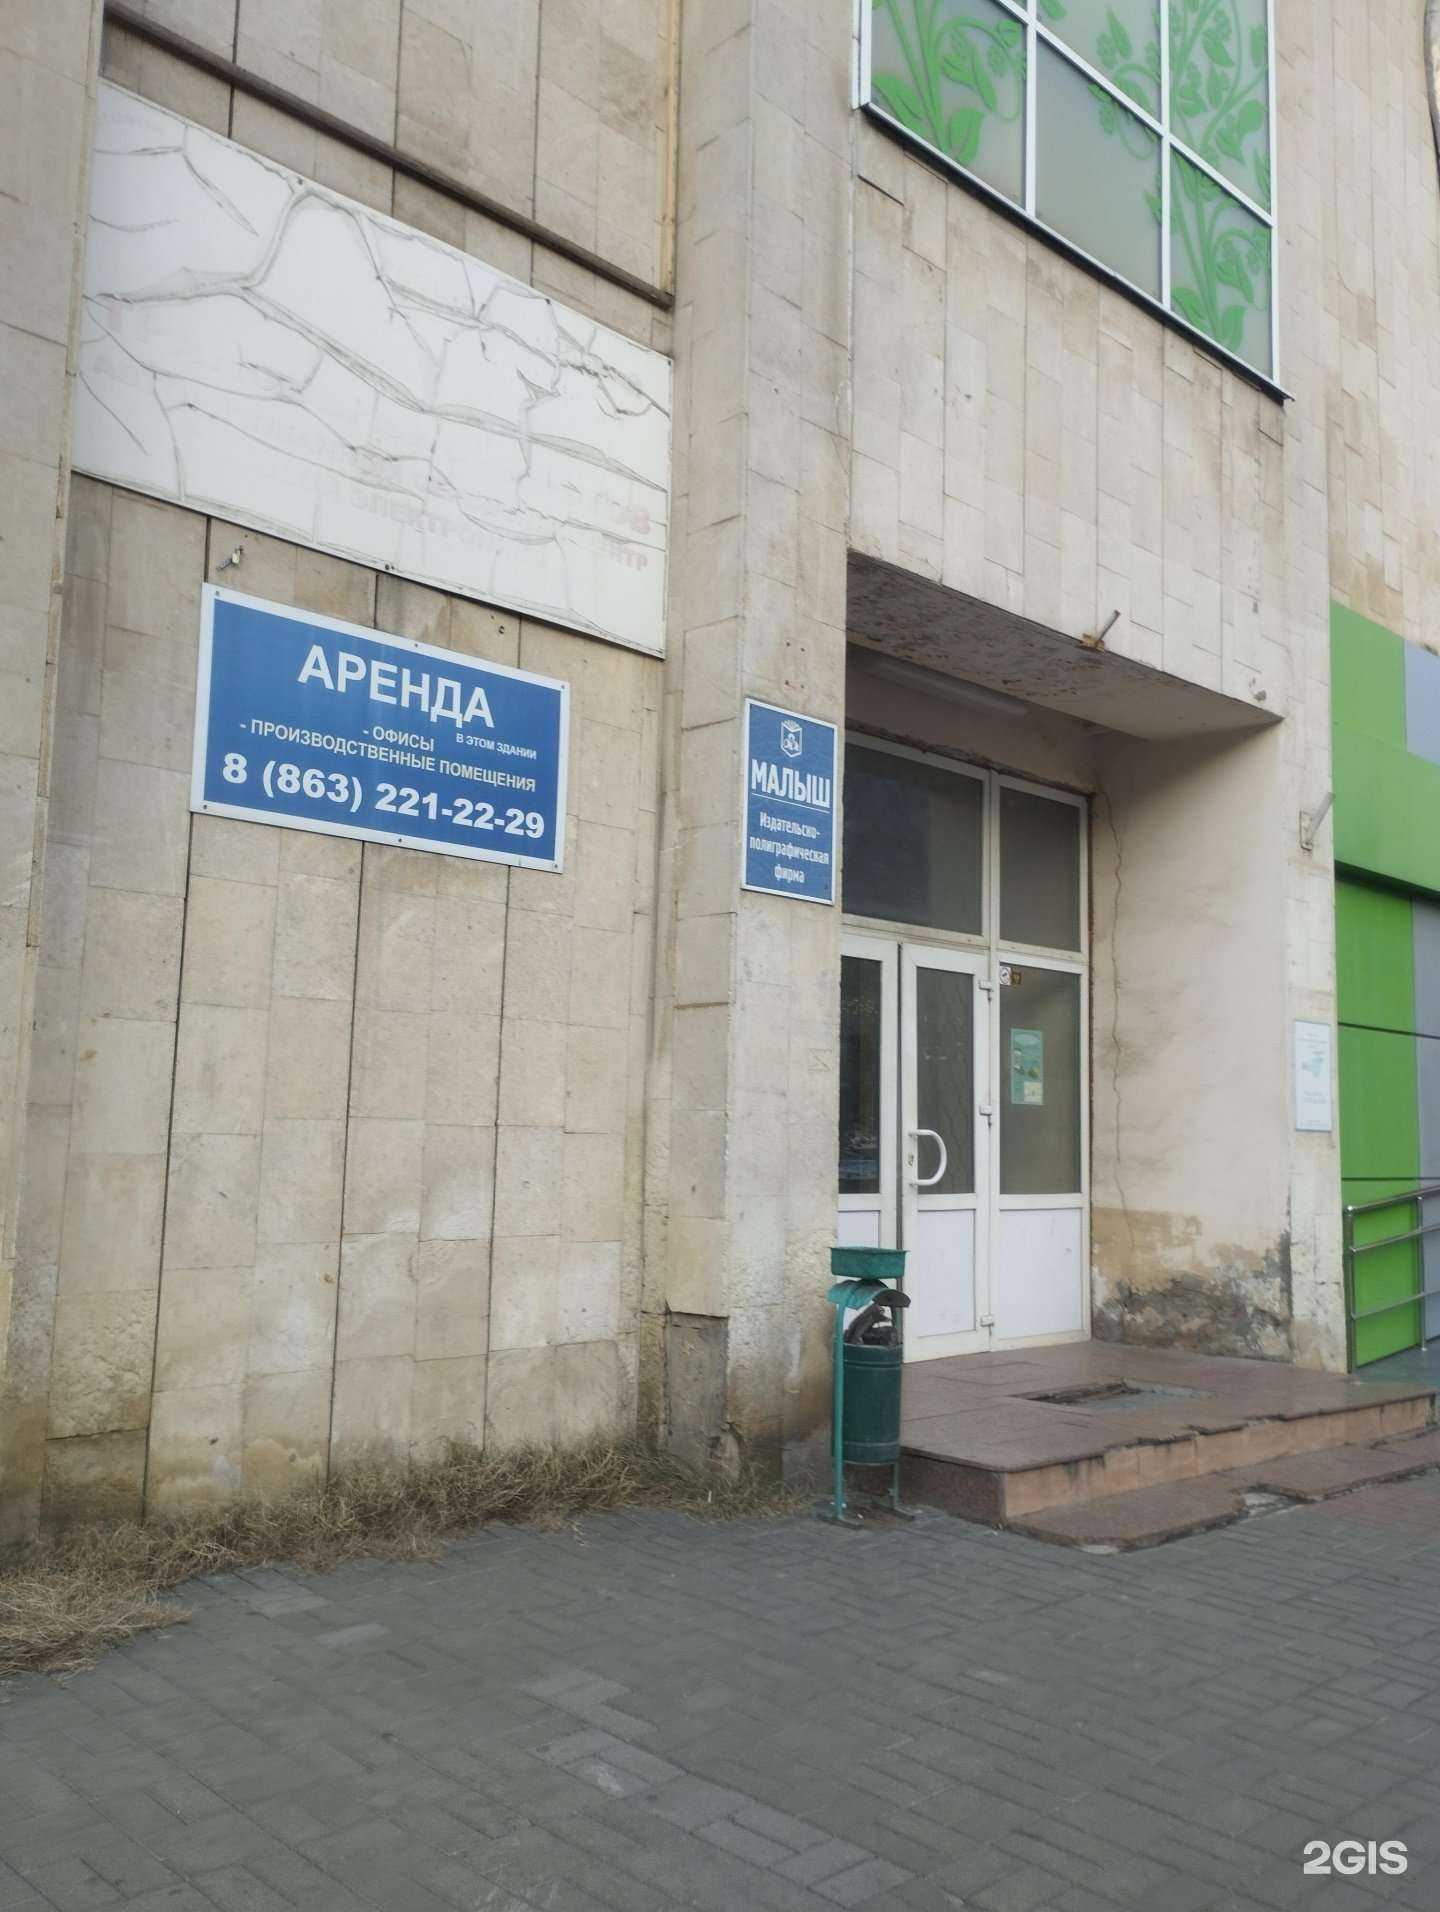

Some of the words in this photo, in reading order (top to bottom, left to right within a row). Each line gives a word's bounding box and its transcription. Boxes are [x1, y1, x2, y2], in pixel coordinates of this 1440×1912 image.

[297, 644, 495, 728] АРЕНДА
[372, 726, 434, 752] ОФИСЫ
[456, 733, 464, 743] В
[466, 735, 494, 752] ЭТОМ
[496, 742, 537, 760] ЗДАНИИ
[251, 719, 436, 772] ПРОИЗВОДСТВЕННЫЕ
[439, 759, 536, 792] ПОМЕЩЕНИЯ
[222, 752, 248, 784] 8
[263, 760, 363, 813] (863)
[375, 782, 545, 839] 221-22-29
[751, 759, 831, 808] МАЛЫШ
[760, 811, 820, 839] Издательско-
[749, 836, 829, 865] полиграфическая
[774, 863, 805, 883] фирма
